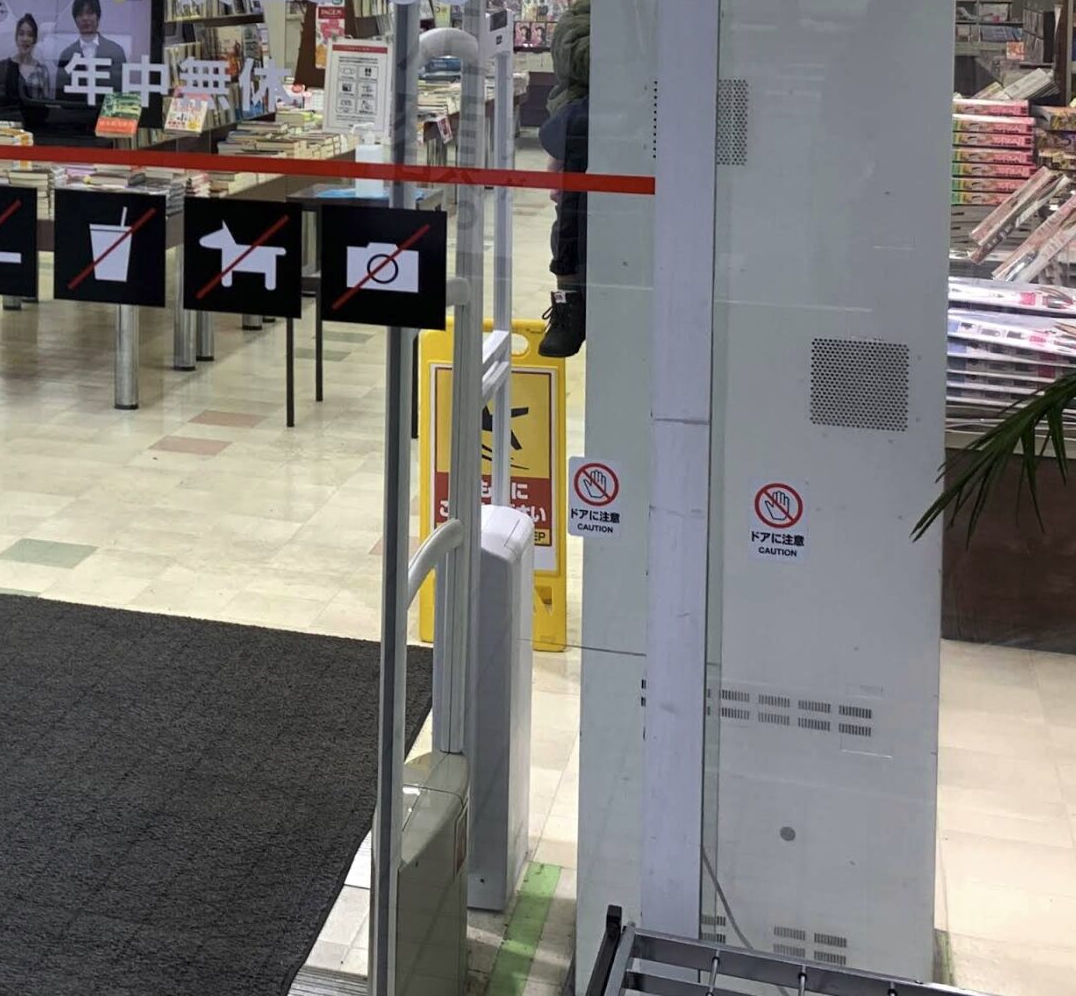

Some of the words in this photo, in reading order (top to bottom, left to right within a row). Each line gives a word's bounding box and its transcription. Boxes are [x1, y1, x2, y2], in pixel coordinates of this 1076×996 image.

[63, 52, 300, 112] 年中無休
[570, 508, 620, 524] ドアに注意
[577, 523, 614, 533] CAUTION
[751, 531, 805, 547] ドアに注意
[758, 546, 798, 557] CAUTION
